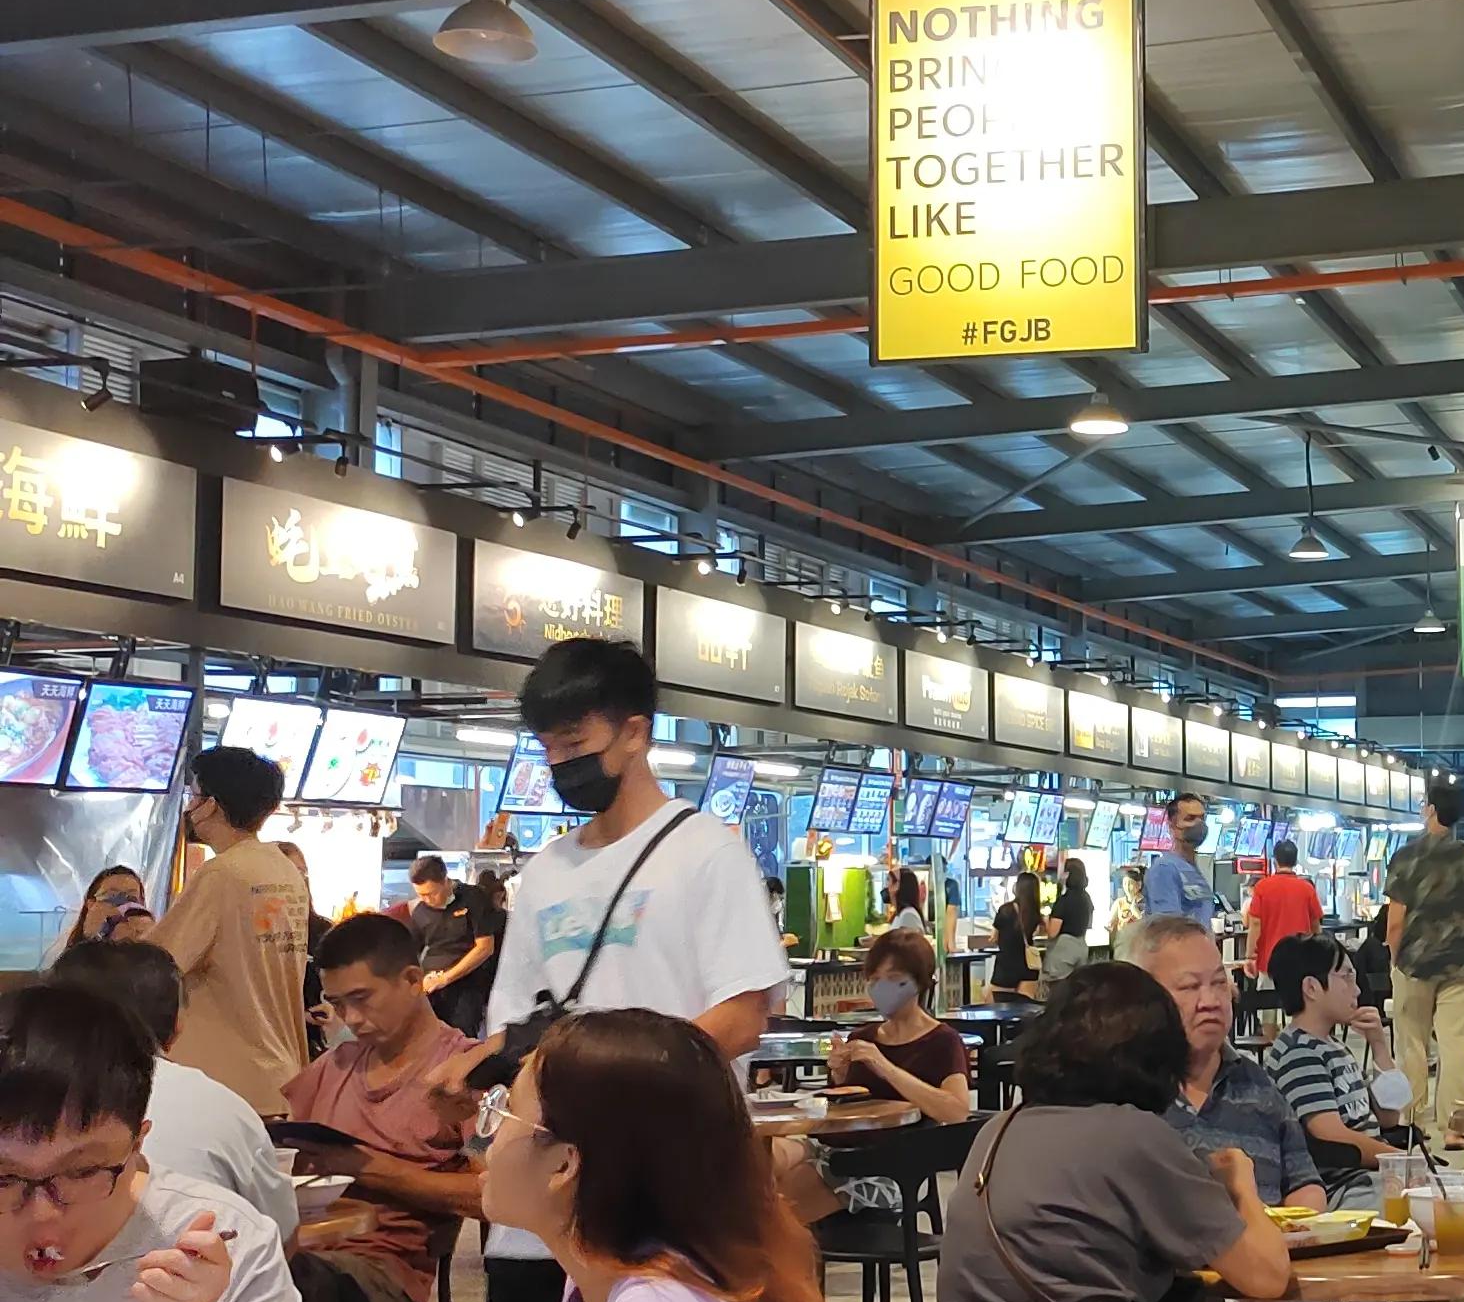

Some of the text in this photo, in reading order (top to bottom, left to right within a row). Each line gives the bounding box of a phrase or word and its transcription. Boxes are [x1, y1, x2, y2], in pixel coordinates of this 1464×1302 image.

[889, 53, 1001, 93] BRIN
[886, 143, 1124, 190] TOGETHER
[889, 201, 976, 240] LIKE
[889, 254, 1124, 296] GOOD FOOD
[962, 318, 1051, 345] #FGJB
[337, 605, 373, 624] FRIED
